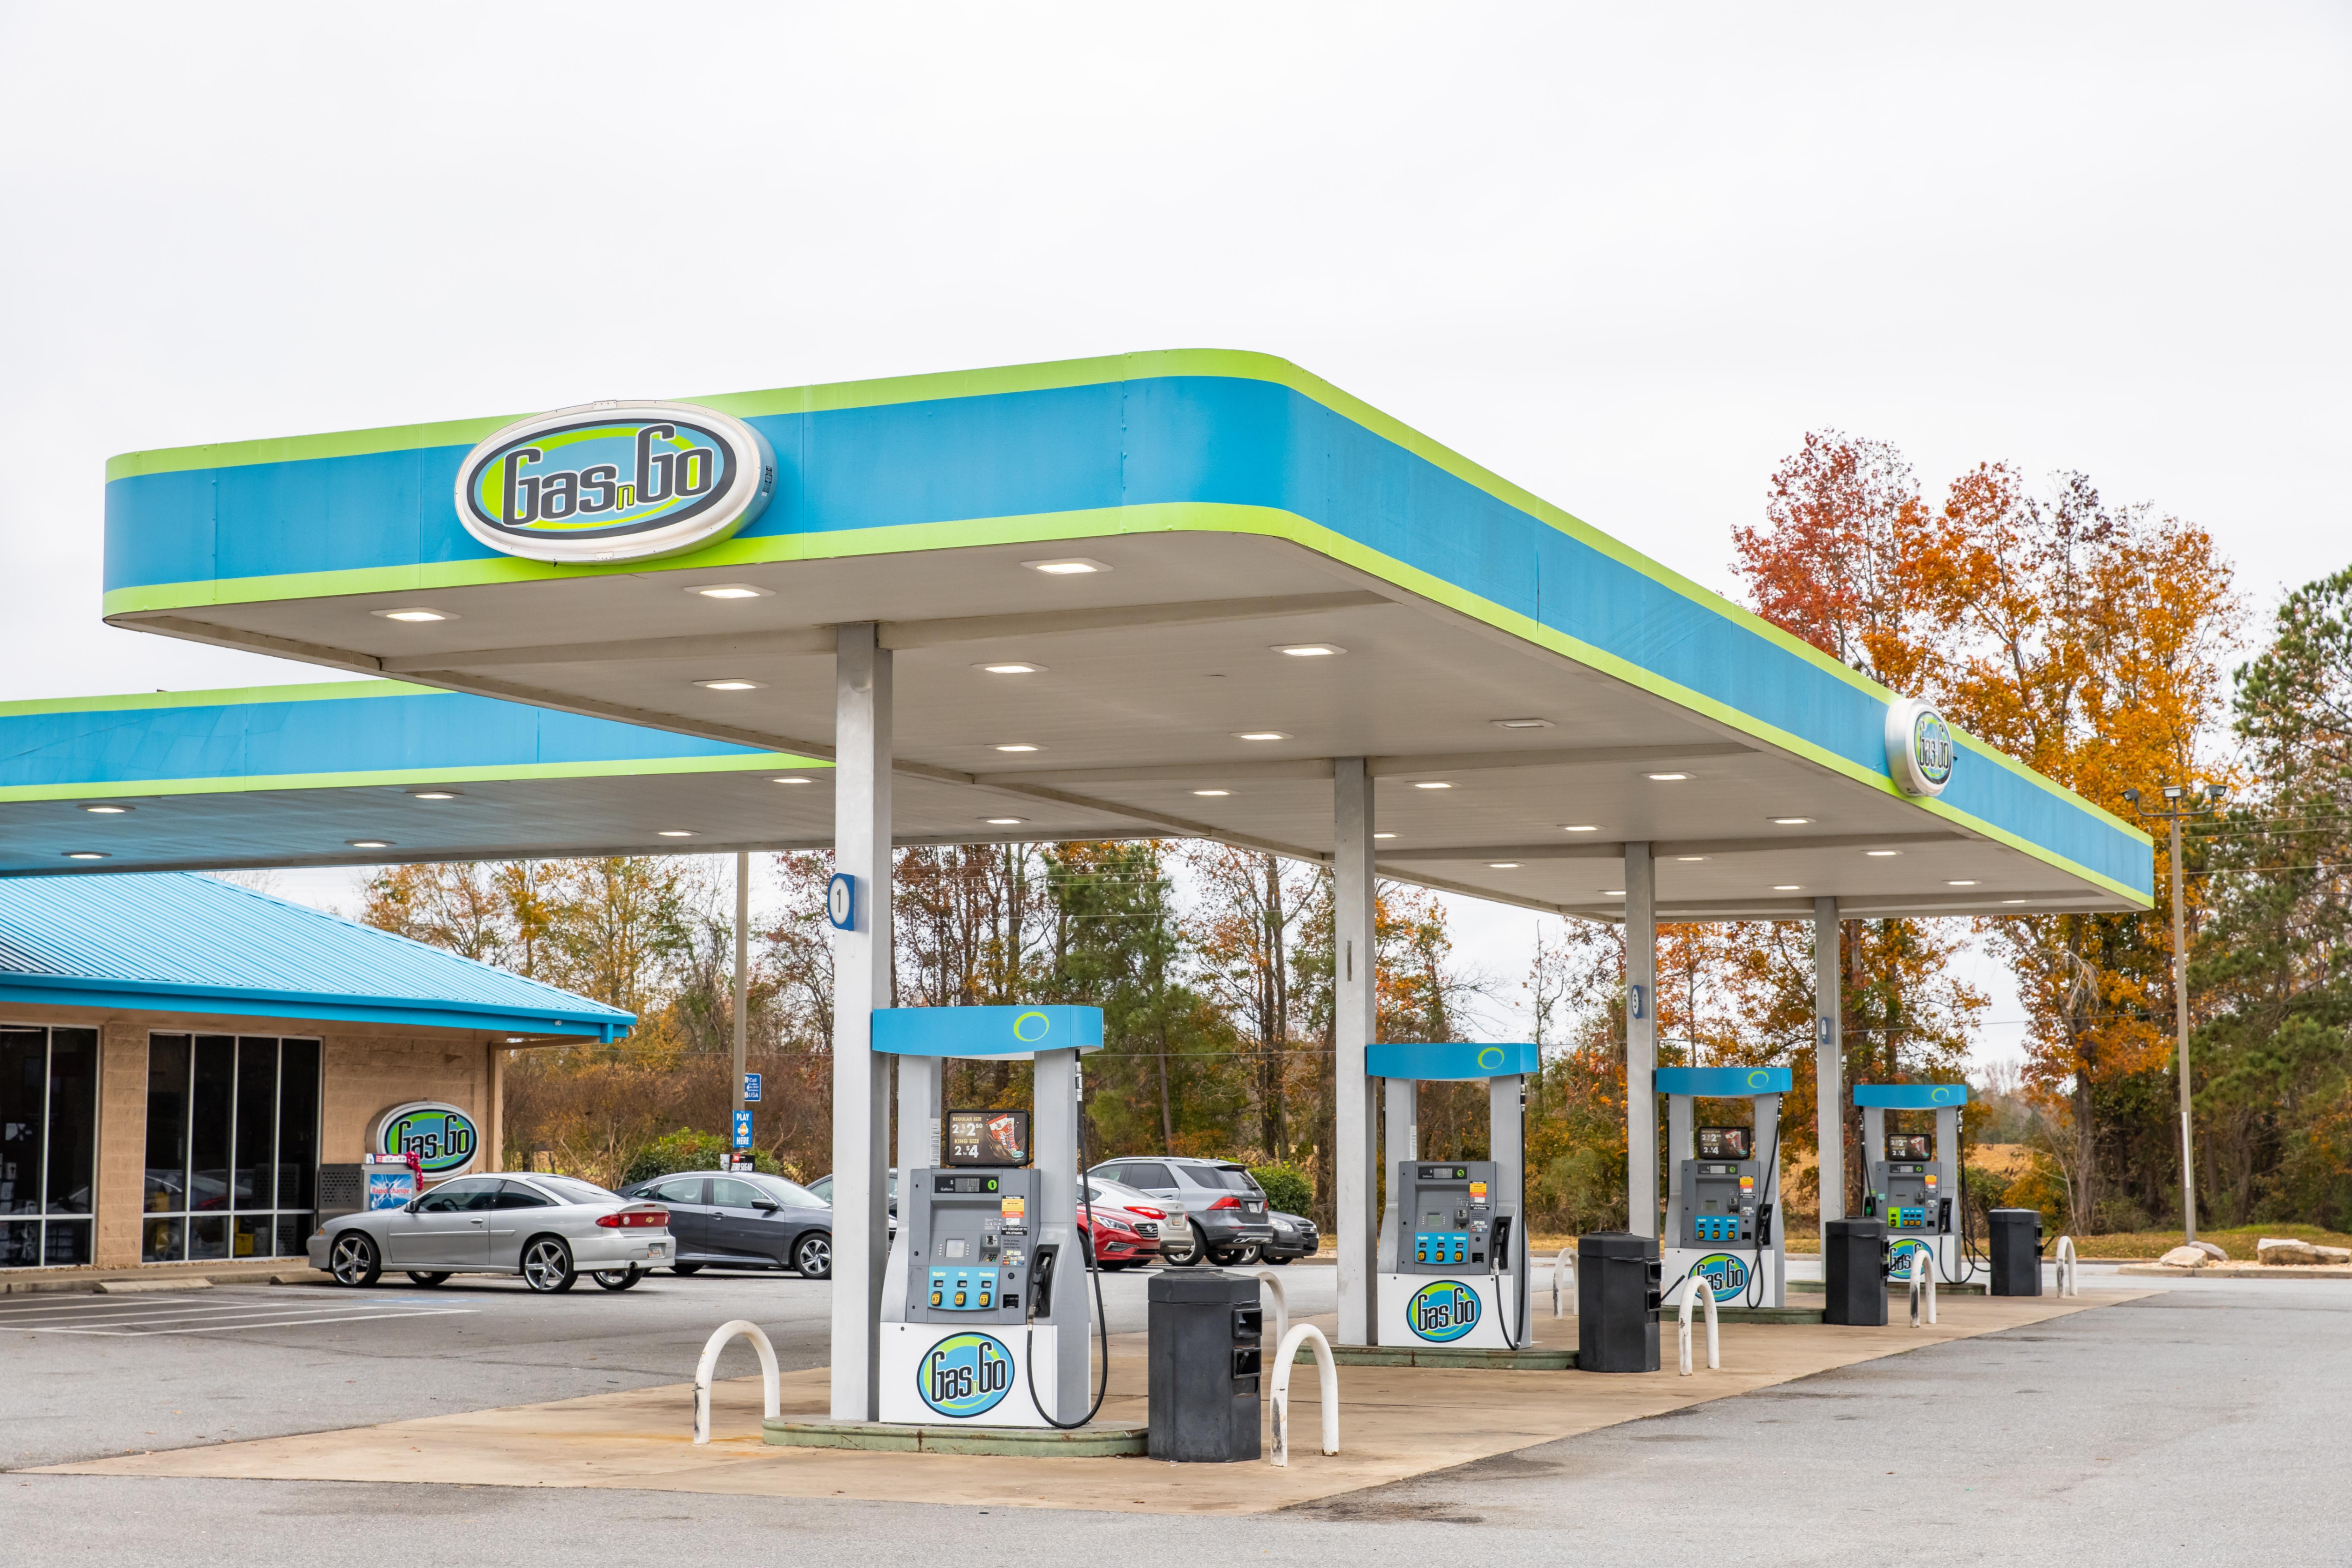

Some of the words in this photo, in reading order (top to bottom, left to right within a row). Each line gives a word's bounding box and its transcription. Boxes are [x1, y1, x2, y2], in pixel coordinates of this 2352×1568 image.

[837, 889, 841, 913] 1
[1634, 994, 1637, 1008] 5
[952, 1124, 959, 1134] 2
[954, 1146, 962, 1156] 2
[731, 1163, 740, 1171] ZERO
